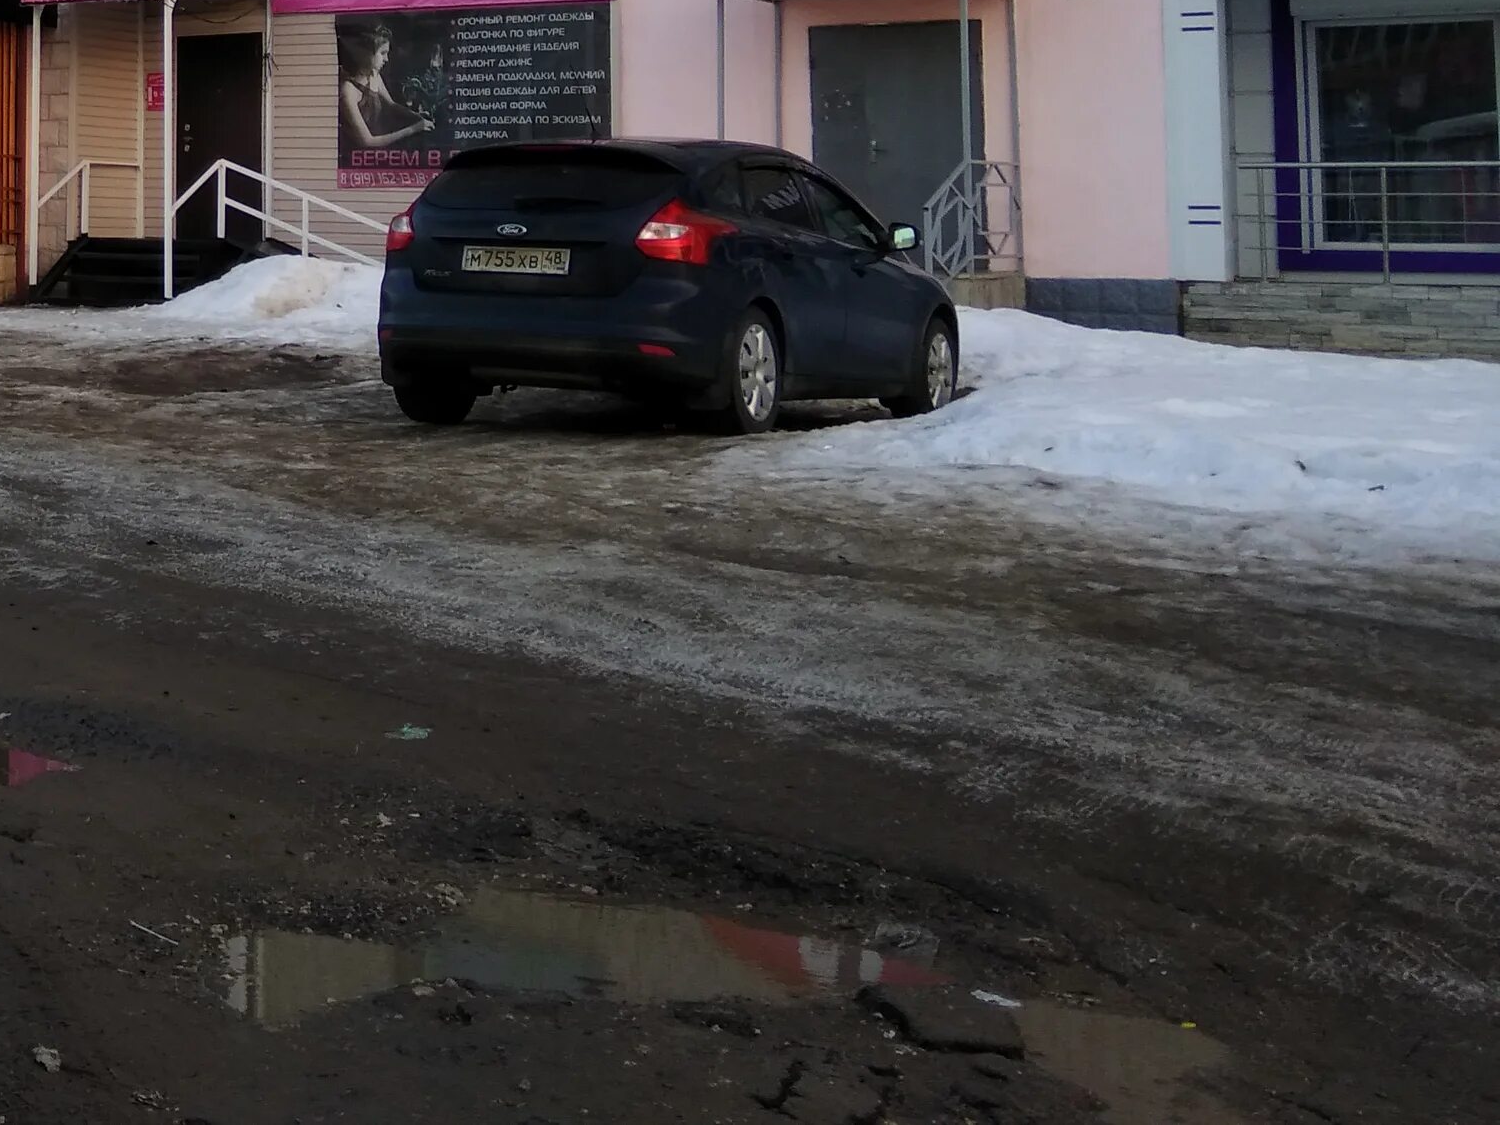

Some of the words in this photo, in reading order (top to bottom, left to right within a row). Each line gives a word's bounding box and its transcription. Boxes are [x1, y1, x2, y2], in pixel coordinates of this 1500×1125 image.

[457, 15, 503, 26] СРОЧНЫЙ
[506, 14, 546, 24] РЕМОНТ
[548, 11, 595, 22] ОДЕЖДЫ
[457, 29, 507, 40] ПОДГОНКА
[510, 29, 524, 38] ПО
[526, 27, 565, 37] ФИГУРЕ
[457, 43, 531, 54] УКОРАЧИВАНИЕ
[533, 41, 580, 51] ИЗДЕЛИЯ
[456, 59, 496, 68] РЕМОНТ
[498, 58, 533, 67] ДЖИНС
[455, 73, 495, 82] ЗАМЕНА
[497, 71, 557, 81] ПОДКЛАДКИ,
[559, 69, 606, 80] МОЛНИЙ
[455, 88, 491, 97] ПОШИВ
[493, 87, 537, 95] ОДЕЖДЫ
[539, 86, 560, 95] ДЛЯ
[563, 84, 597, 95] ДЕТЕЙ
[455, 101, 507, 111] ШКОЛЬНАЯ
[509, 101, 547, 110] ФОРМА
[454, 116, 488, 125] ЛЮБАЯ
[490, 115, 533, 124] ОДЕЖДА
[535, 115, 549, 124] ПО
[552, 114, 602, 124] ЭСКИЗАМ
[454, 130, 509, 139] ЗАКАЗЧИКА
[351, 150, 420, 166] БЕРЕМ
[427, 150, 441, 166] В
[340, 172, 347, 185] 8
[350, 172, 376, 187] (919)
